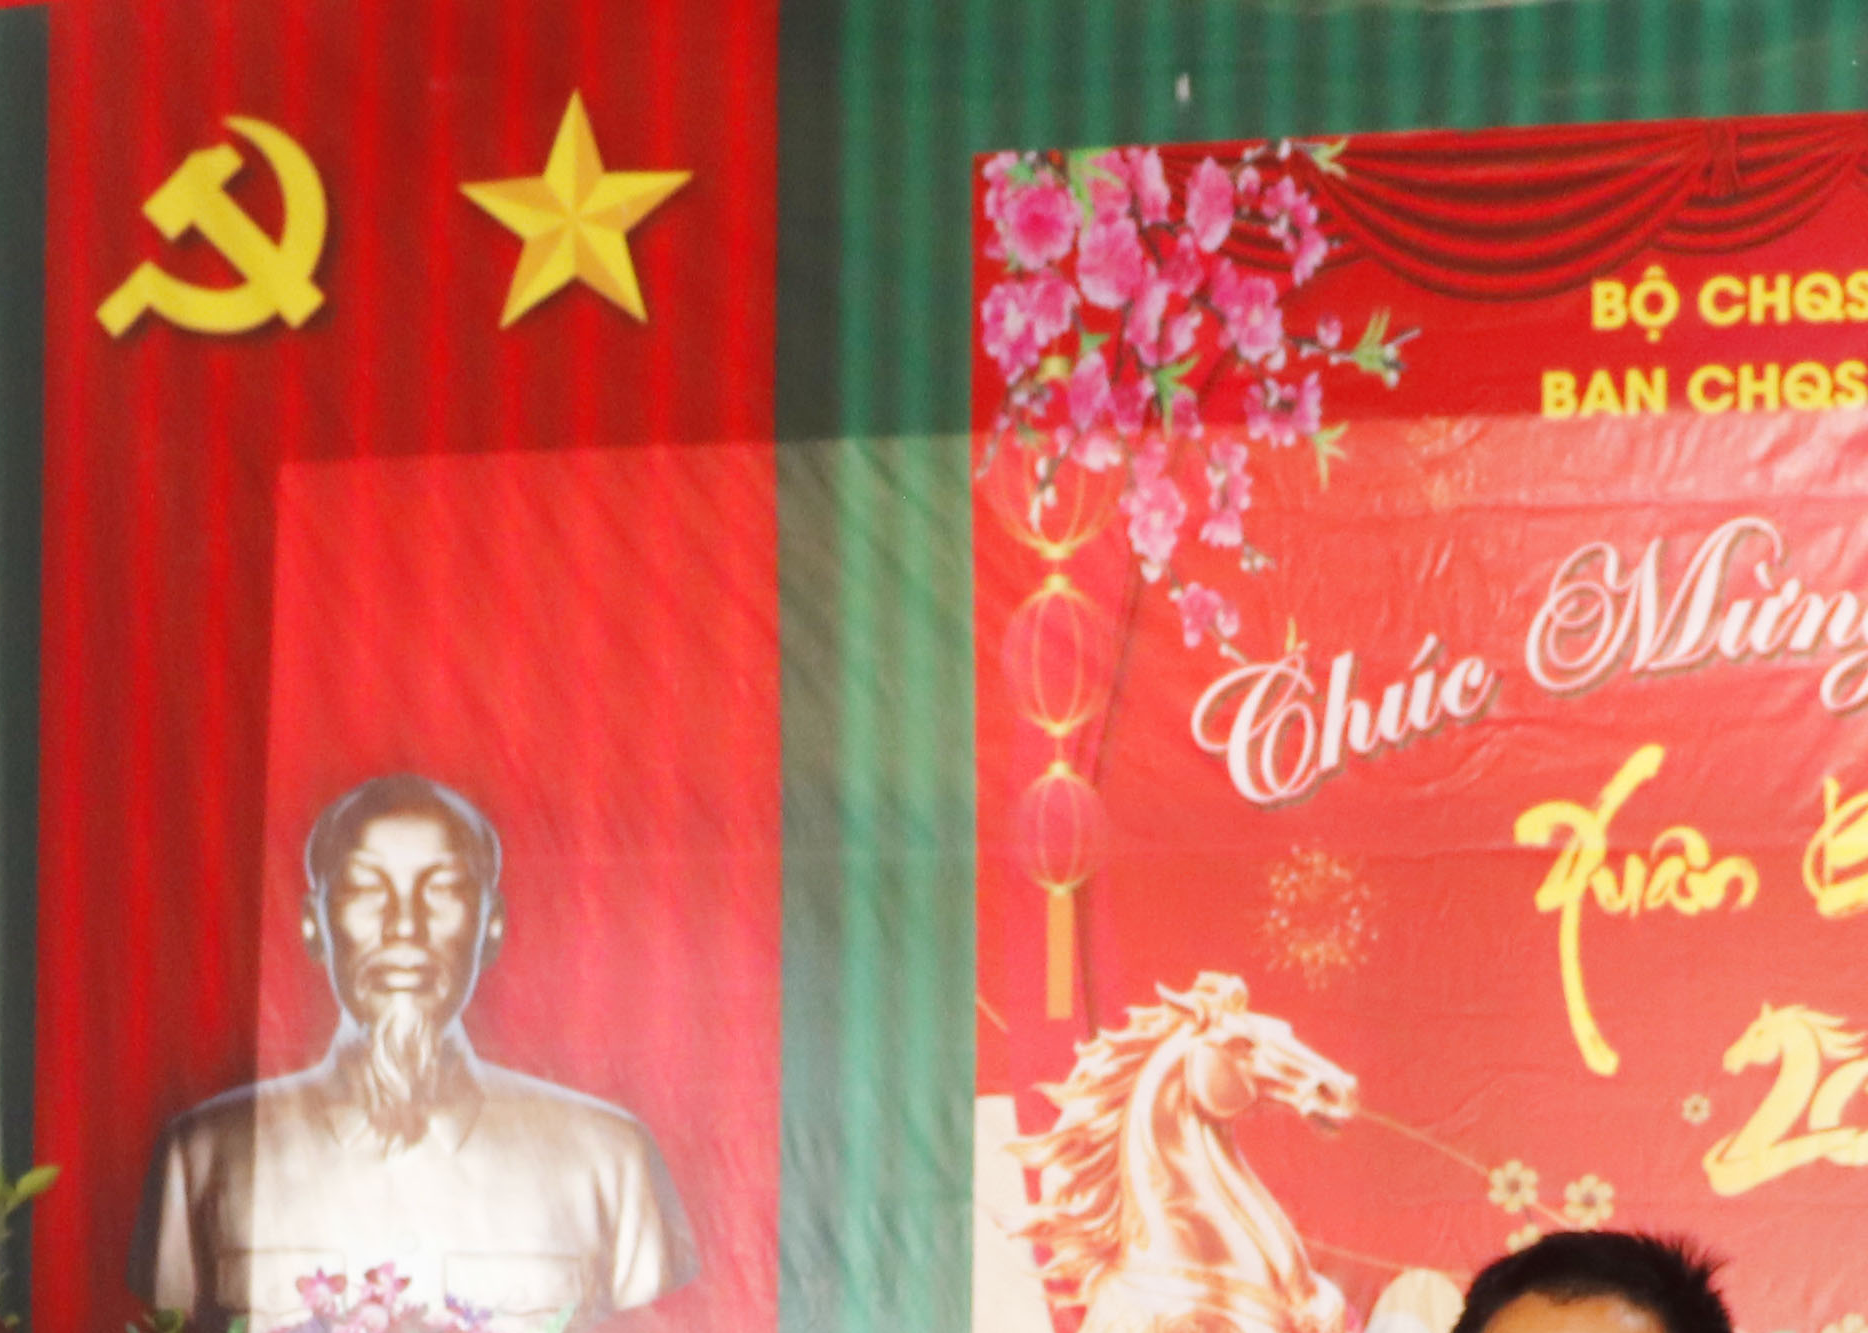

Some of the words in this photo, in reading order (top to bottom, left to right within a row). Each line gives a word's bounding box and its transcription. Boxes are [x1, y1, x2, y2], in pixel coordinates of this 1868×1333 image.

[1591, 265, 1678, 343] BỘ
[1541, 368, 1668, 419] BAN
[1190, 634, 1495, 804] Chúc
[1514, 744, 1759, 1077] Xuân
